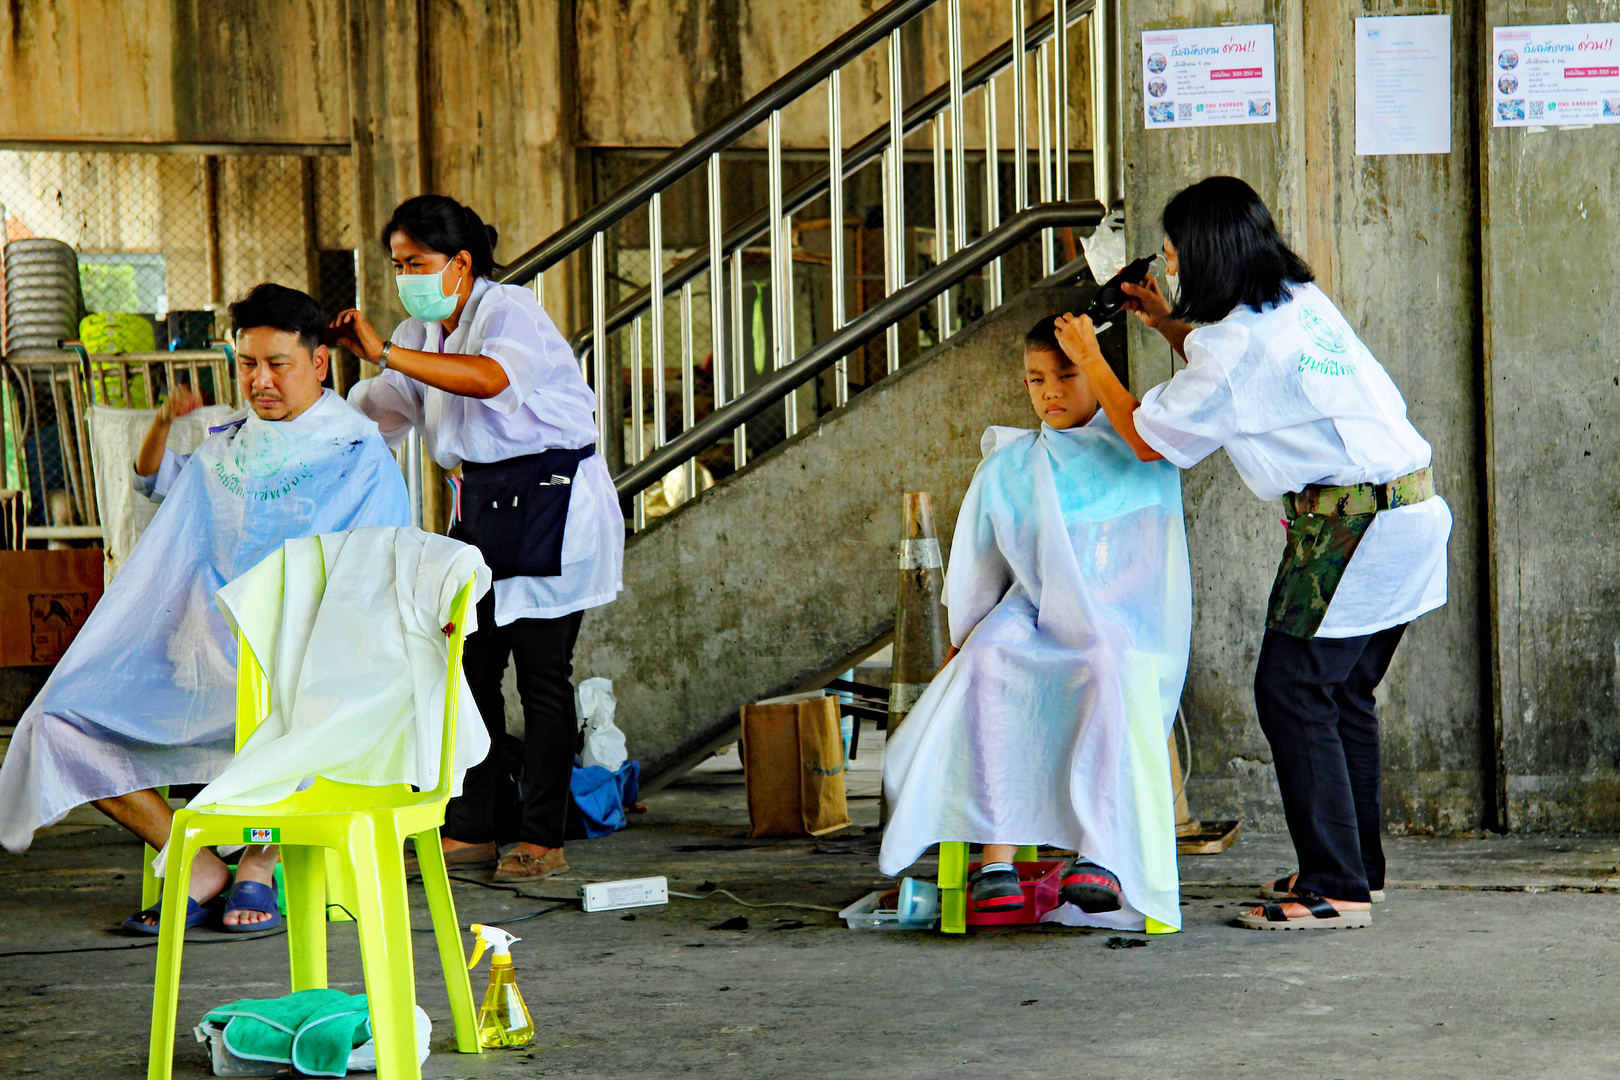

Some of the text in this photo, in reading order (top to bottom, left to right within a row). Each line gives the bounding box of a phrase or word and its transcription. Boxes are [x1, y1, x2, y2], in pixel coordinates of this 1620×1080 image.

[1171, 36, 1255, 56] รับสมัครงาน ด่วน!!
[1523, 34, 1613, 53] รับสมัครงาน ด่วน!!
